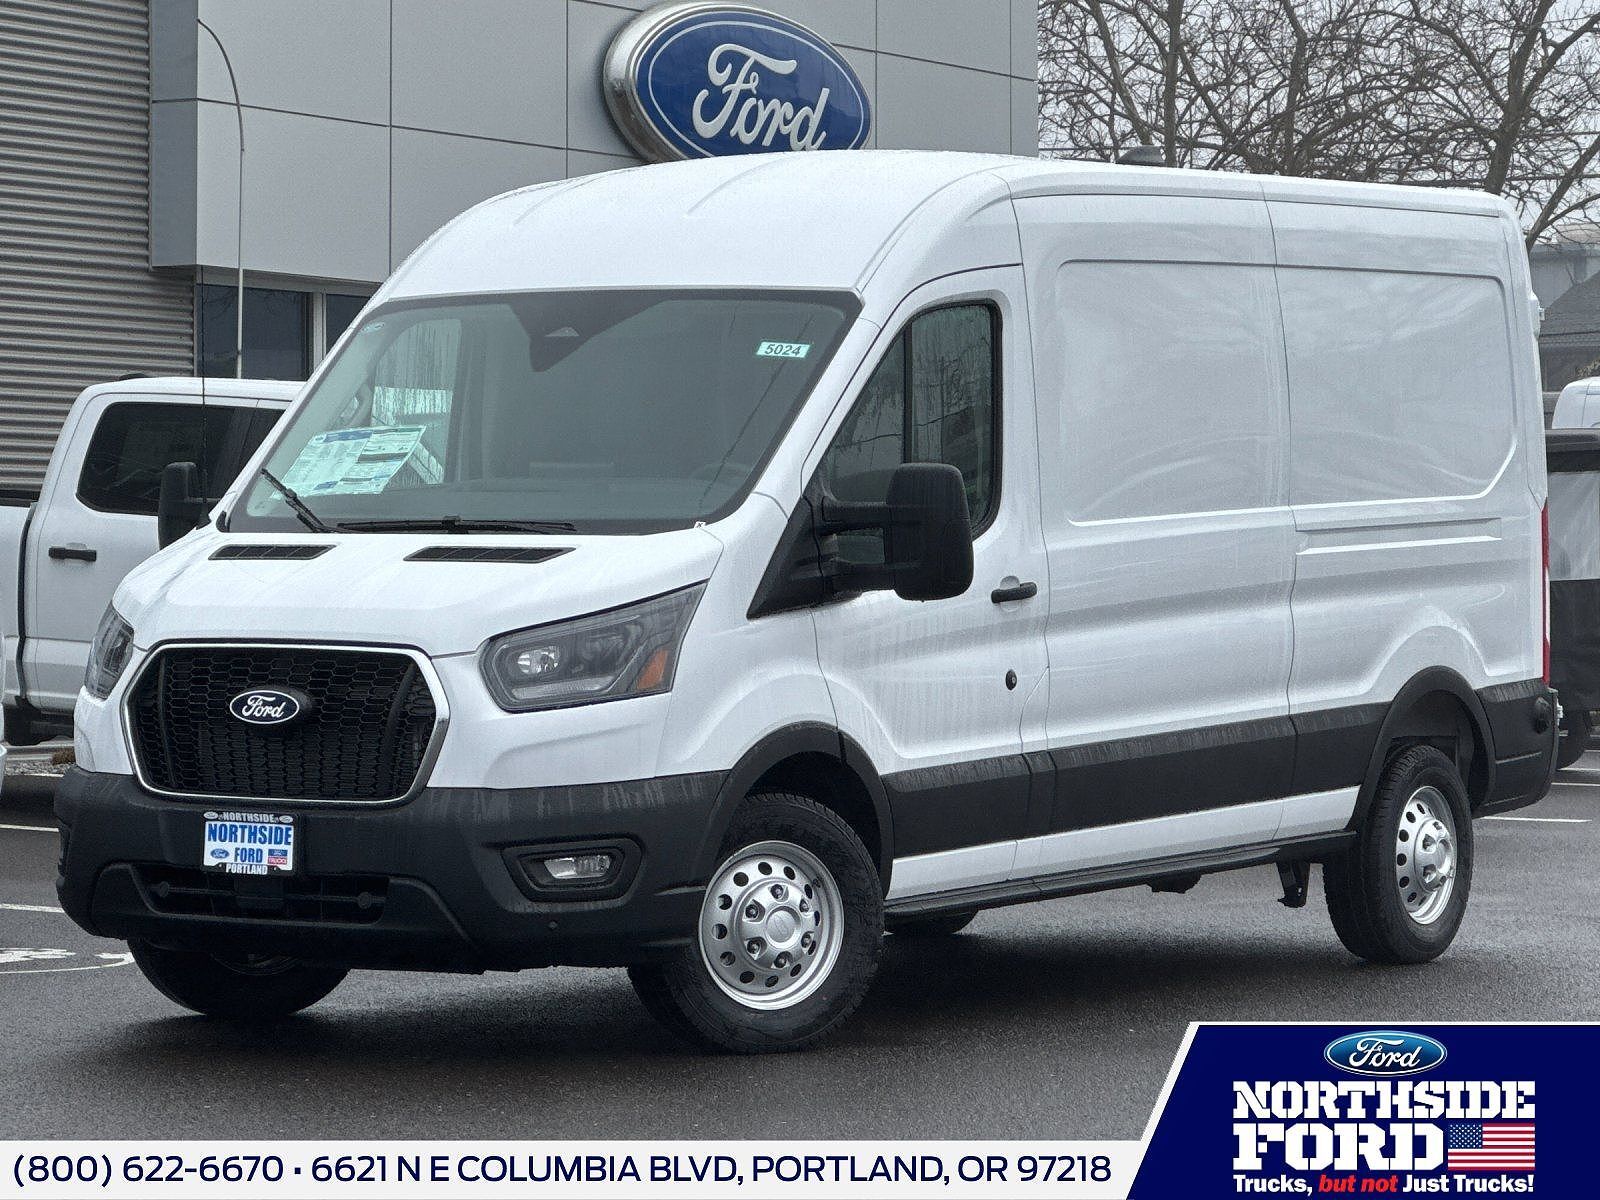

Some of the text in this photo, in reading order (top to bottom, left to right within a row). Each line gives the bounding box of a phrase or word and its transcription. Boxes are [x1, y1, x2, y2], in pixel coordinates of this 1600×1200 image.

[692, 43, 830, 151] Ford
[765, 344, 801, 356] 5024
[242, 695, 285, 717] Ford
[223, 812, 275, 823] NORTHSIDE
[208, 823, 291, 845] NORTHSIDE
[234, 848, 263, 862] FORD
[226, 864, 268, 874] PORTLAND
